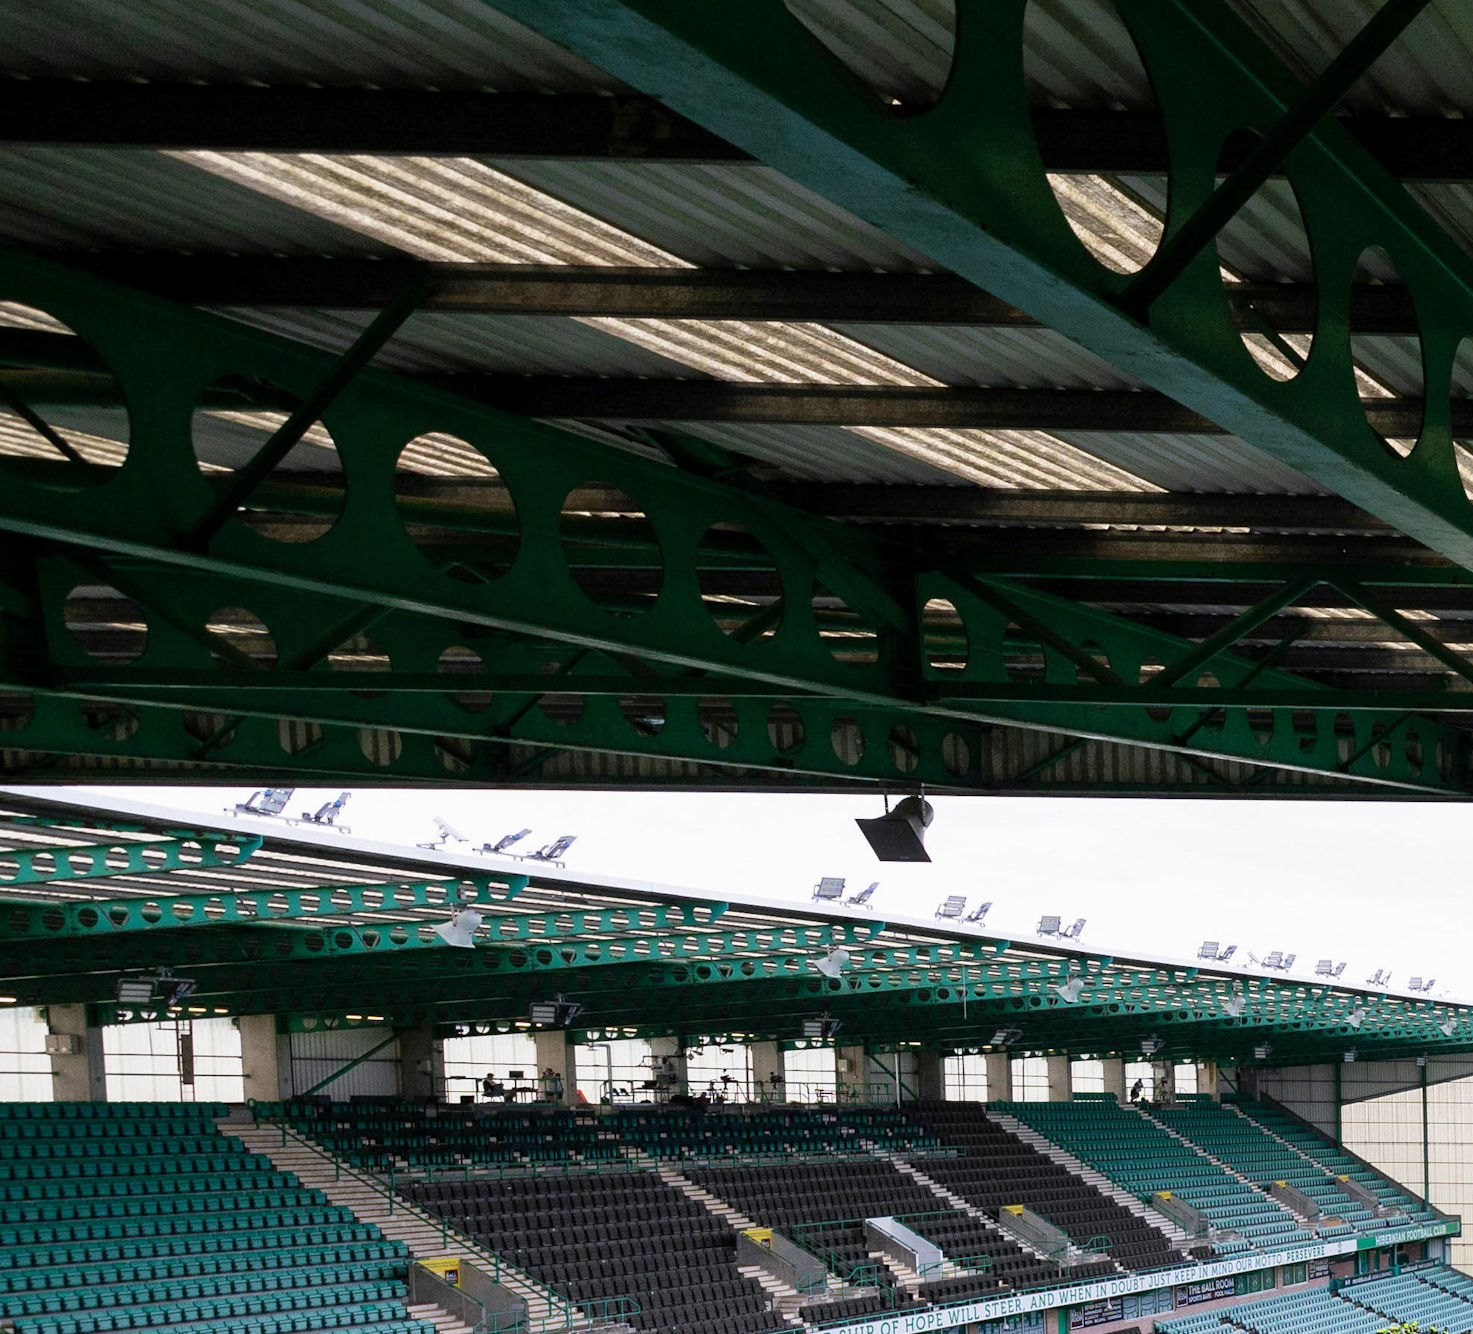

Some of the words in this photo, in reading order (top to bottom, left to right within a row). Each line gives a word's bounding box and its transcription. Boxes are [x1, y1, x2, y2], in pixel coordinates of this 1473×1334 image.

[905, 1314, 943, 1333] HOPE
[949, 1306, 980, 1325] WILL
[1030, 1293, 1055, 1309] AND
[1059, 1286, 1092, 1304] WHEN
[1096, 1283, 1107, 1297] IN
[1111, 1277, 1145, 1294] DOUBT
[1148, 1272, 1171, 1288] JUST
[1174, 1269, 1196, 1284] KEEP
[1199, 1266, 1209, 1279] IN
[1211, 1261, 1233, 1276] MIND
[1236, 1258, 1251, 1272] OUR
[1254, 1253, 1283, 1268] MOTTO
[1286, 1246, 1325, 1261] PERSEVERE
